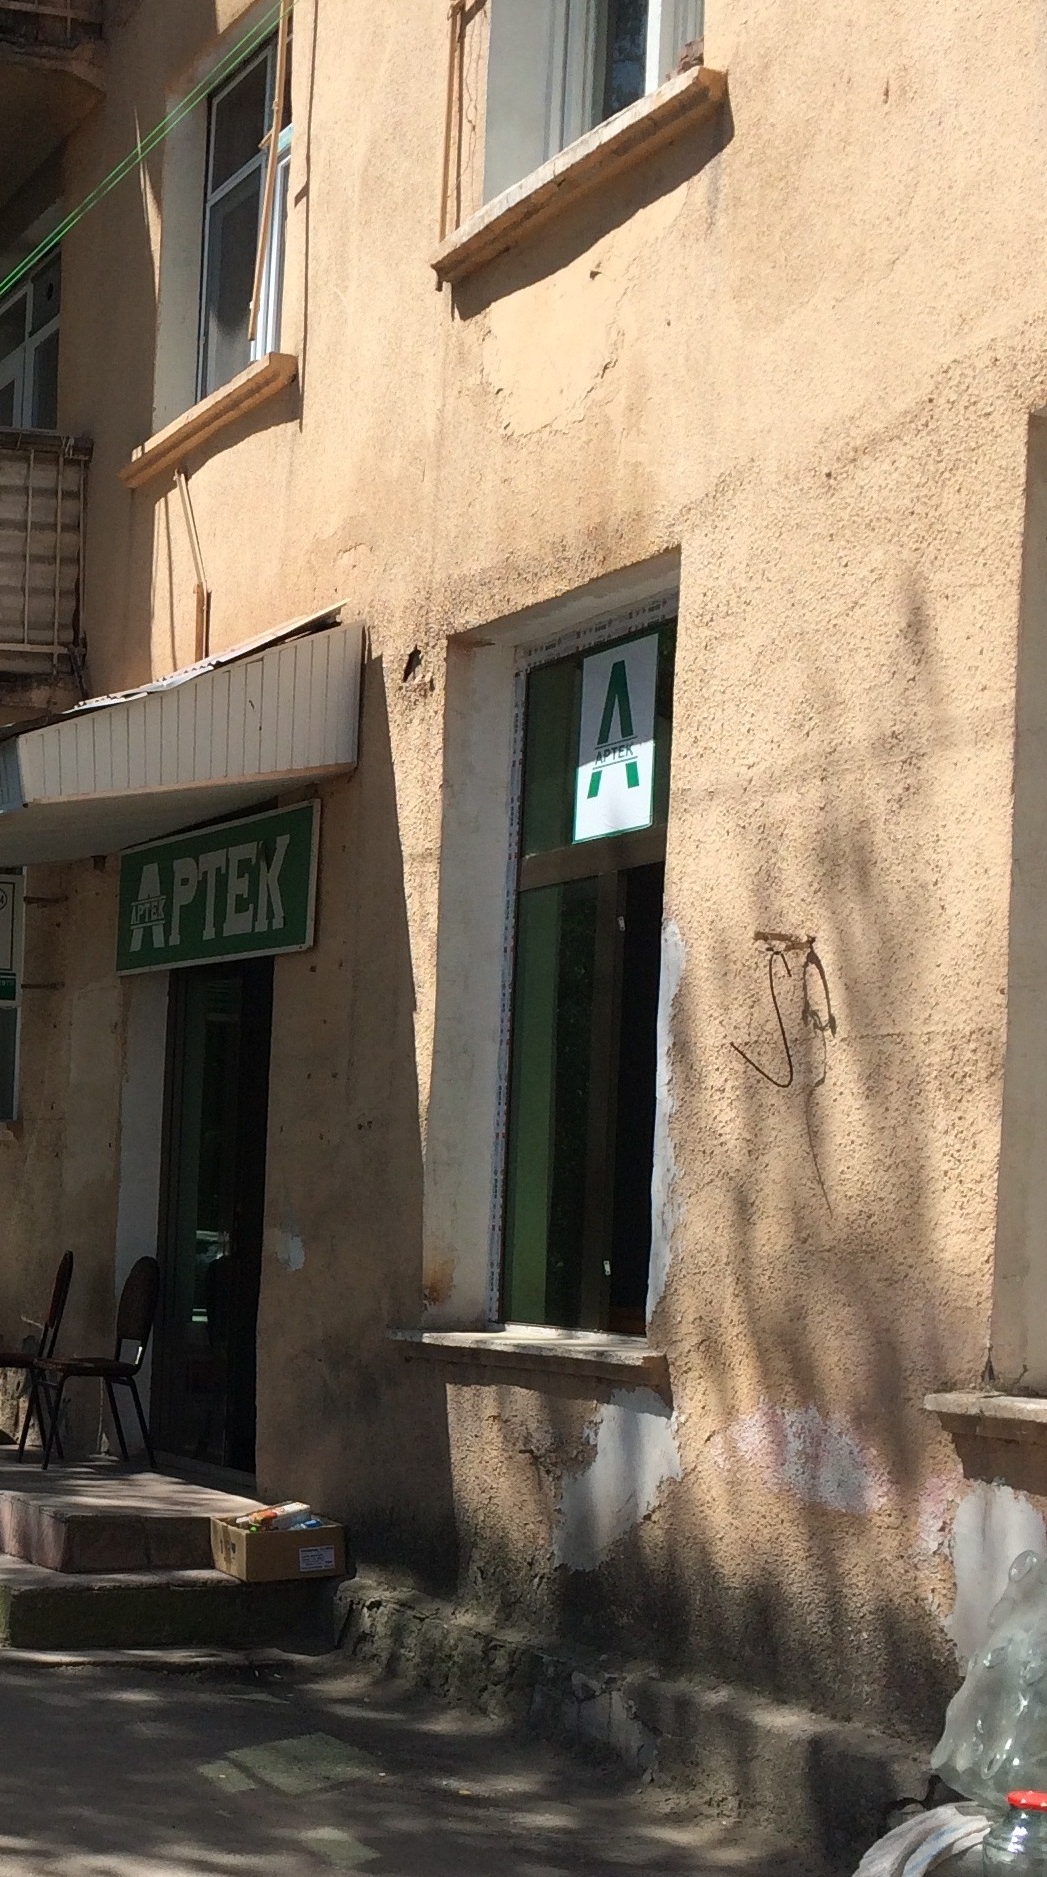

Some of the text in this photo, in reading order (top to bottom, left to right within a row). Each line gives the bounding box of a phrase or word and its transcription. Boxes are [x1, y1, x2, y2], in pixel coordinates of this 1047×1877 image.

[595, 743, 634, 765] APTEK
[129, 834, 290, 952] APTEK
[130, 898, 165, 925] APTEK
